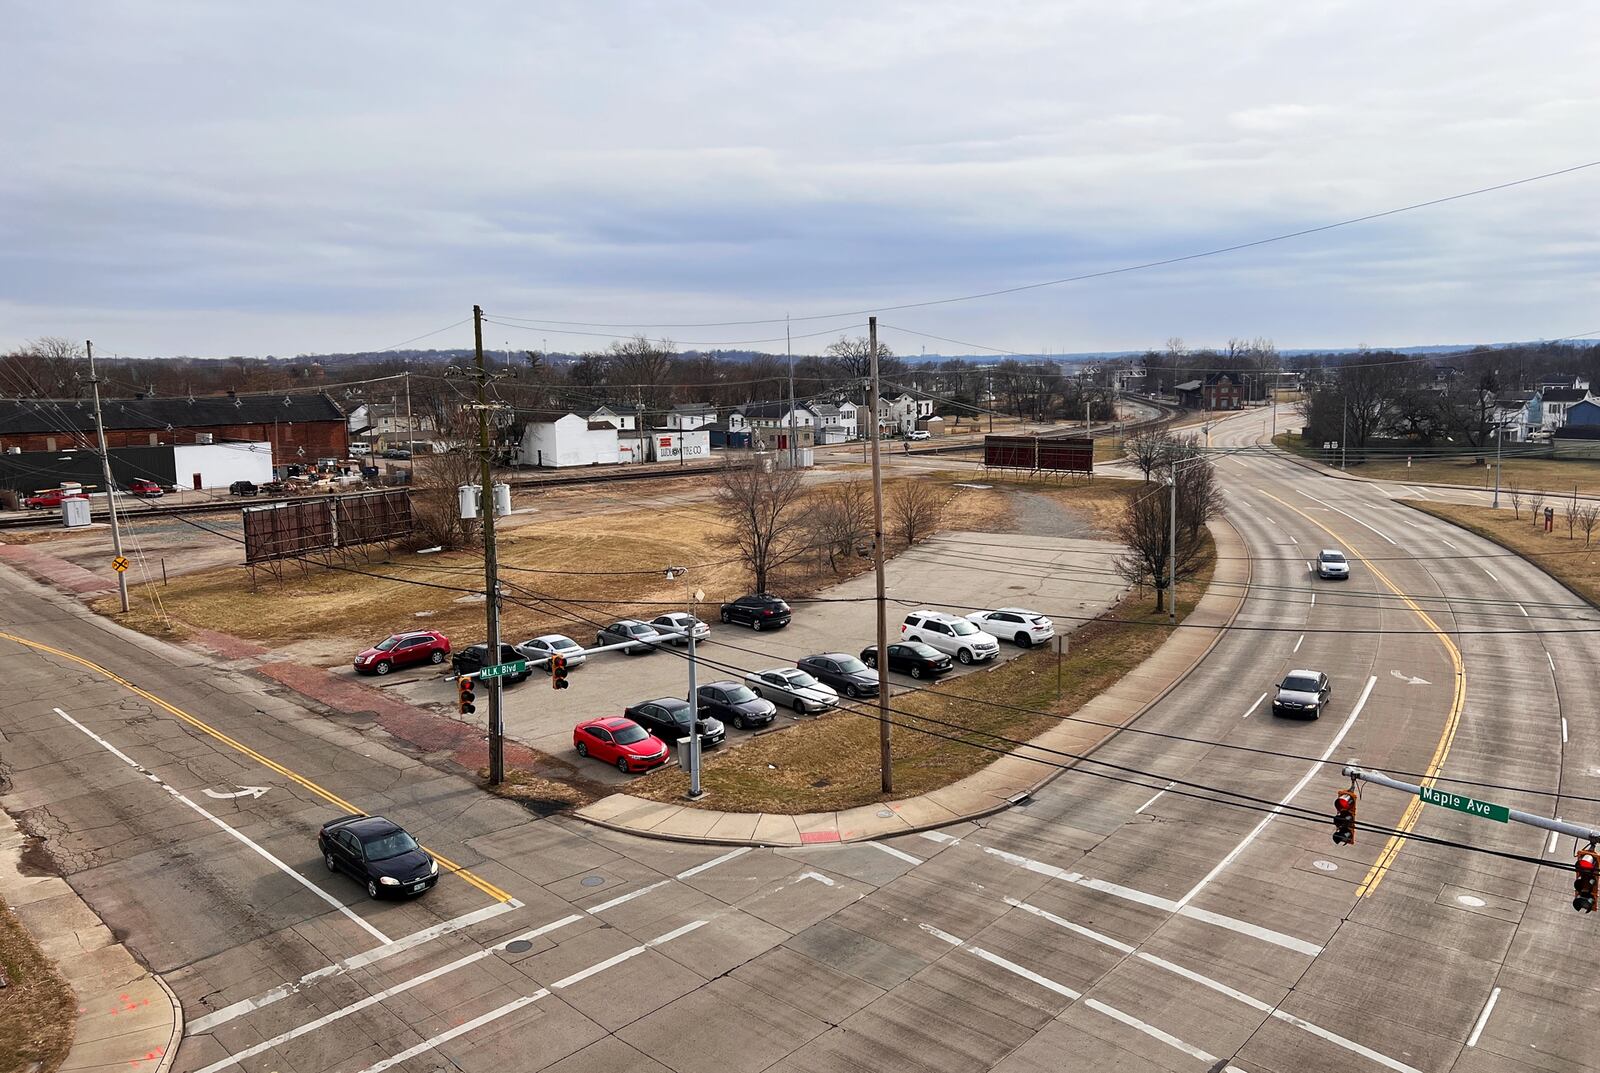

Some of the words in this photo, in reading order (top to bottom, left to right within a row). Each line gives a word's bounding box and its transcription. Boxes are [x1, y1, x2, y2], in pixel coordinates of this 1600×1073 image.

[502, 664, 516, 673] Blvd
[1423, 787, 1460, 806] Maple
[1467, 799, 1491, 815] Ave
